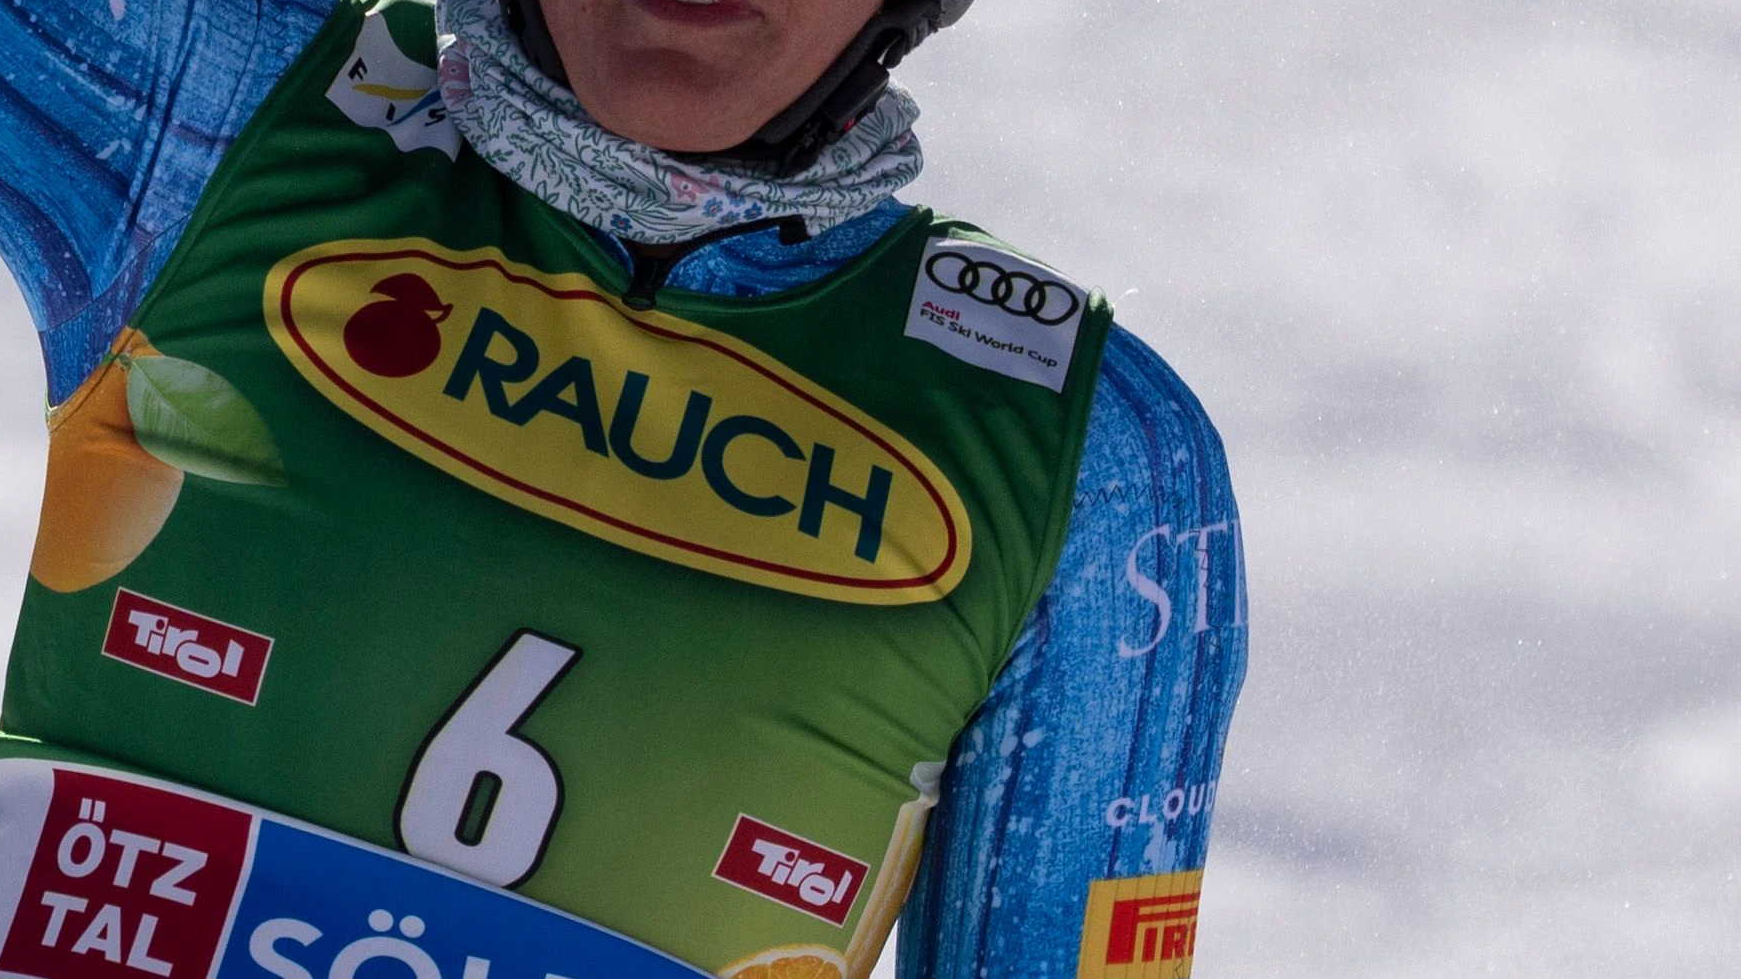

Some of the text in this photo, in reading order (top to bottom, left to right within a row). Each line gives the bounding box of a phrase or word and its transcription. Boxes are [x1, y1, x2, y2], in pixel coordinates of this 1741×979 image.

[920, 308, 1058, 368] FIS Ski World Cup
[922, 300, 961, 321] Audi
[443, 307, 894, 564] RAUCH
[128, 609, 245, 678] Tirol
[393, 627, 583, 889] 6
[57, 798, 208, 906] ÖTZ
[751, 838, 853, 906] Tirol
[41, 891, 173, 977] TAL
